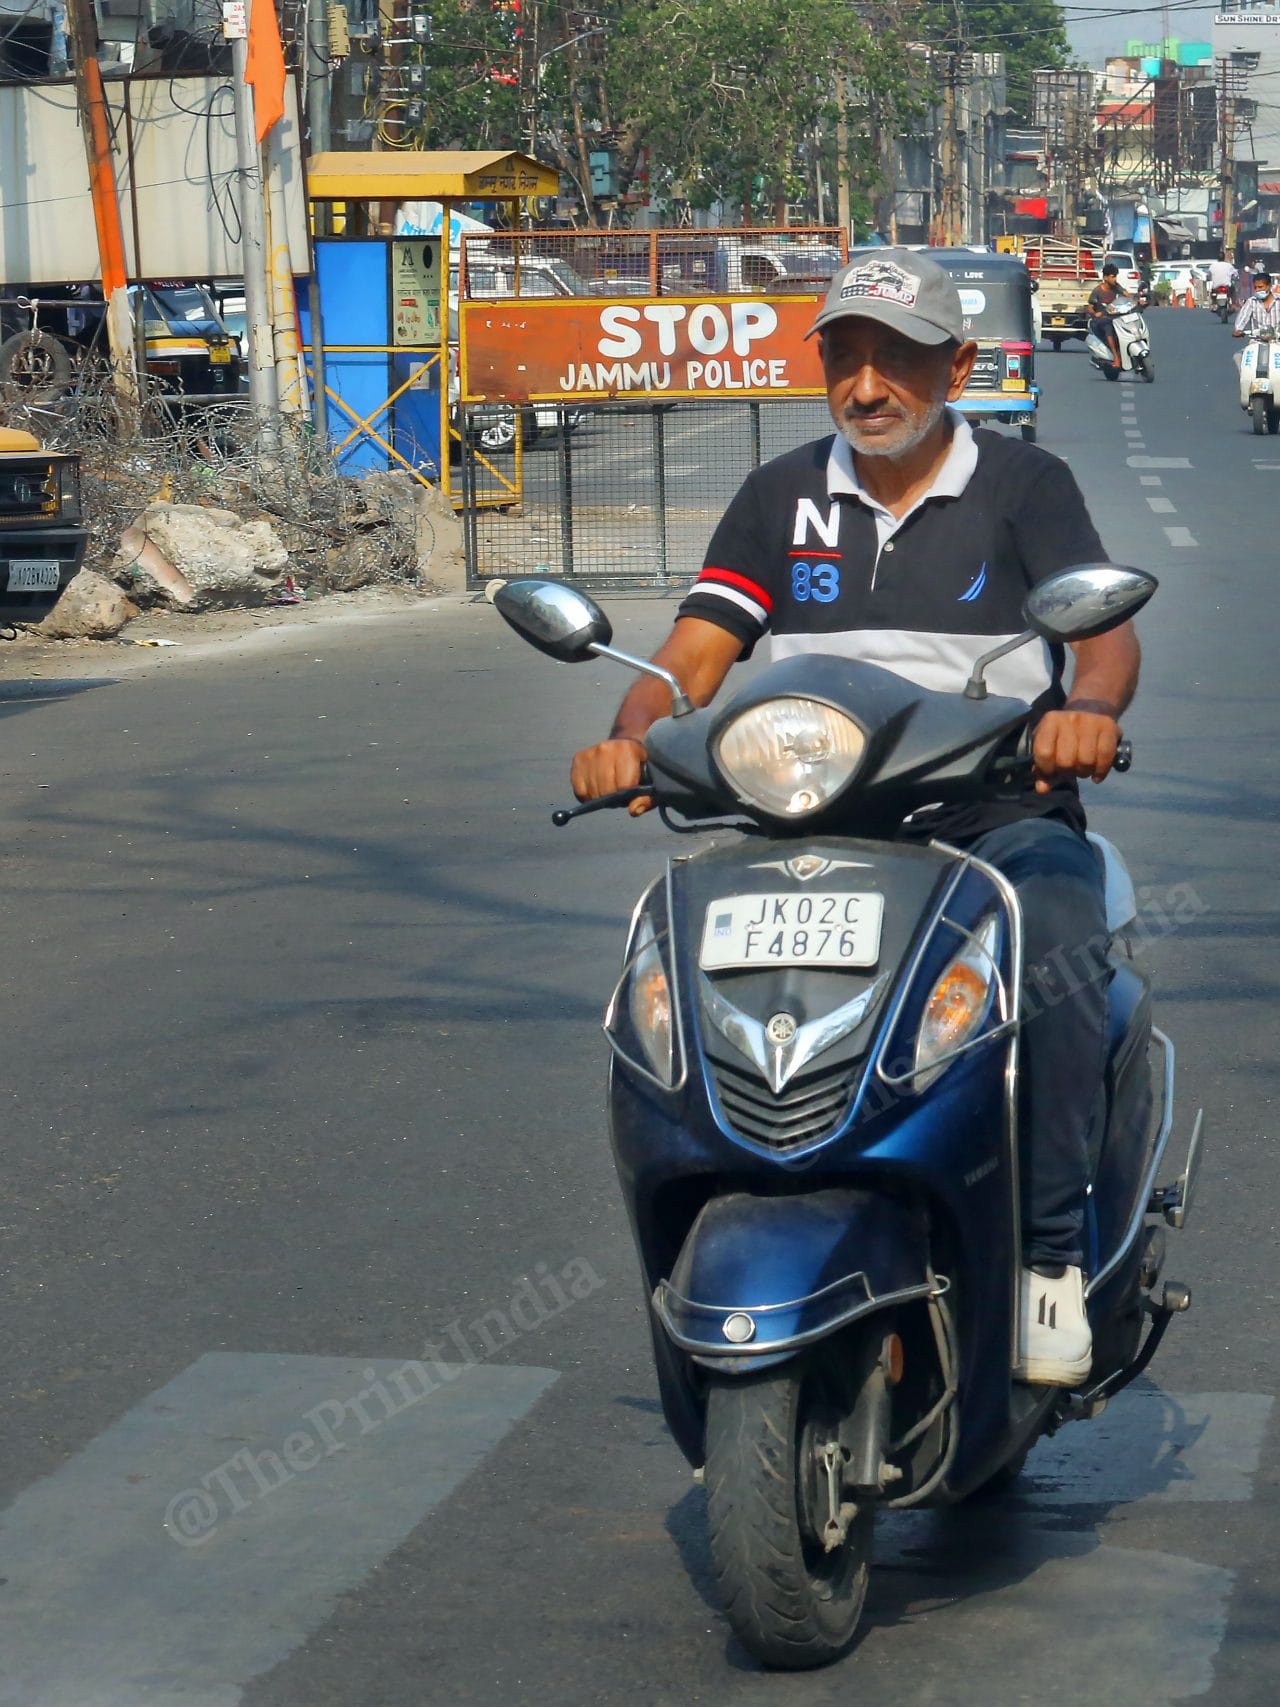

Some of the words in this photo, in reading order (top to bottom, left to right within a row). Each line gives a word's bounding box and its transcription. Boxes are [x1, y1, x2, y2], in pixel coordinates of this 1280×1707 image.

[1238, 15, 1264, 23] SHINE
[598, 302, 778, 358] STOP
[559, 361, 671, 392] JAMMU
[687, 359, 790, 390] POLICE
[793, 498, 840, 547] N
[792, 562, 840, 603] 83
[749, 897, 860, 925] JK02C
[745, 930, 856, 959] F4876
